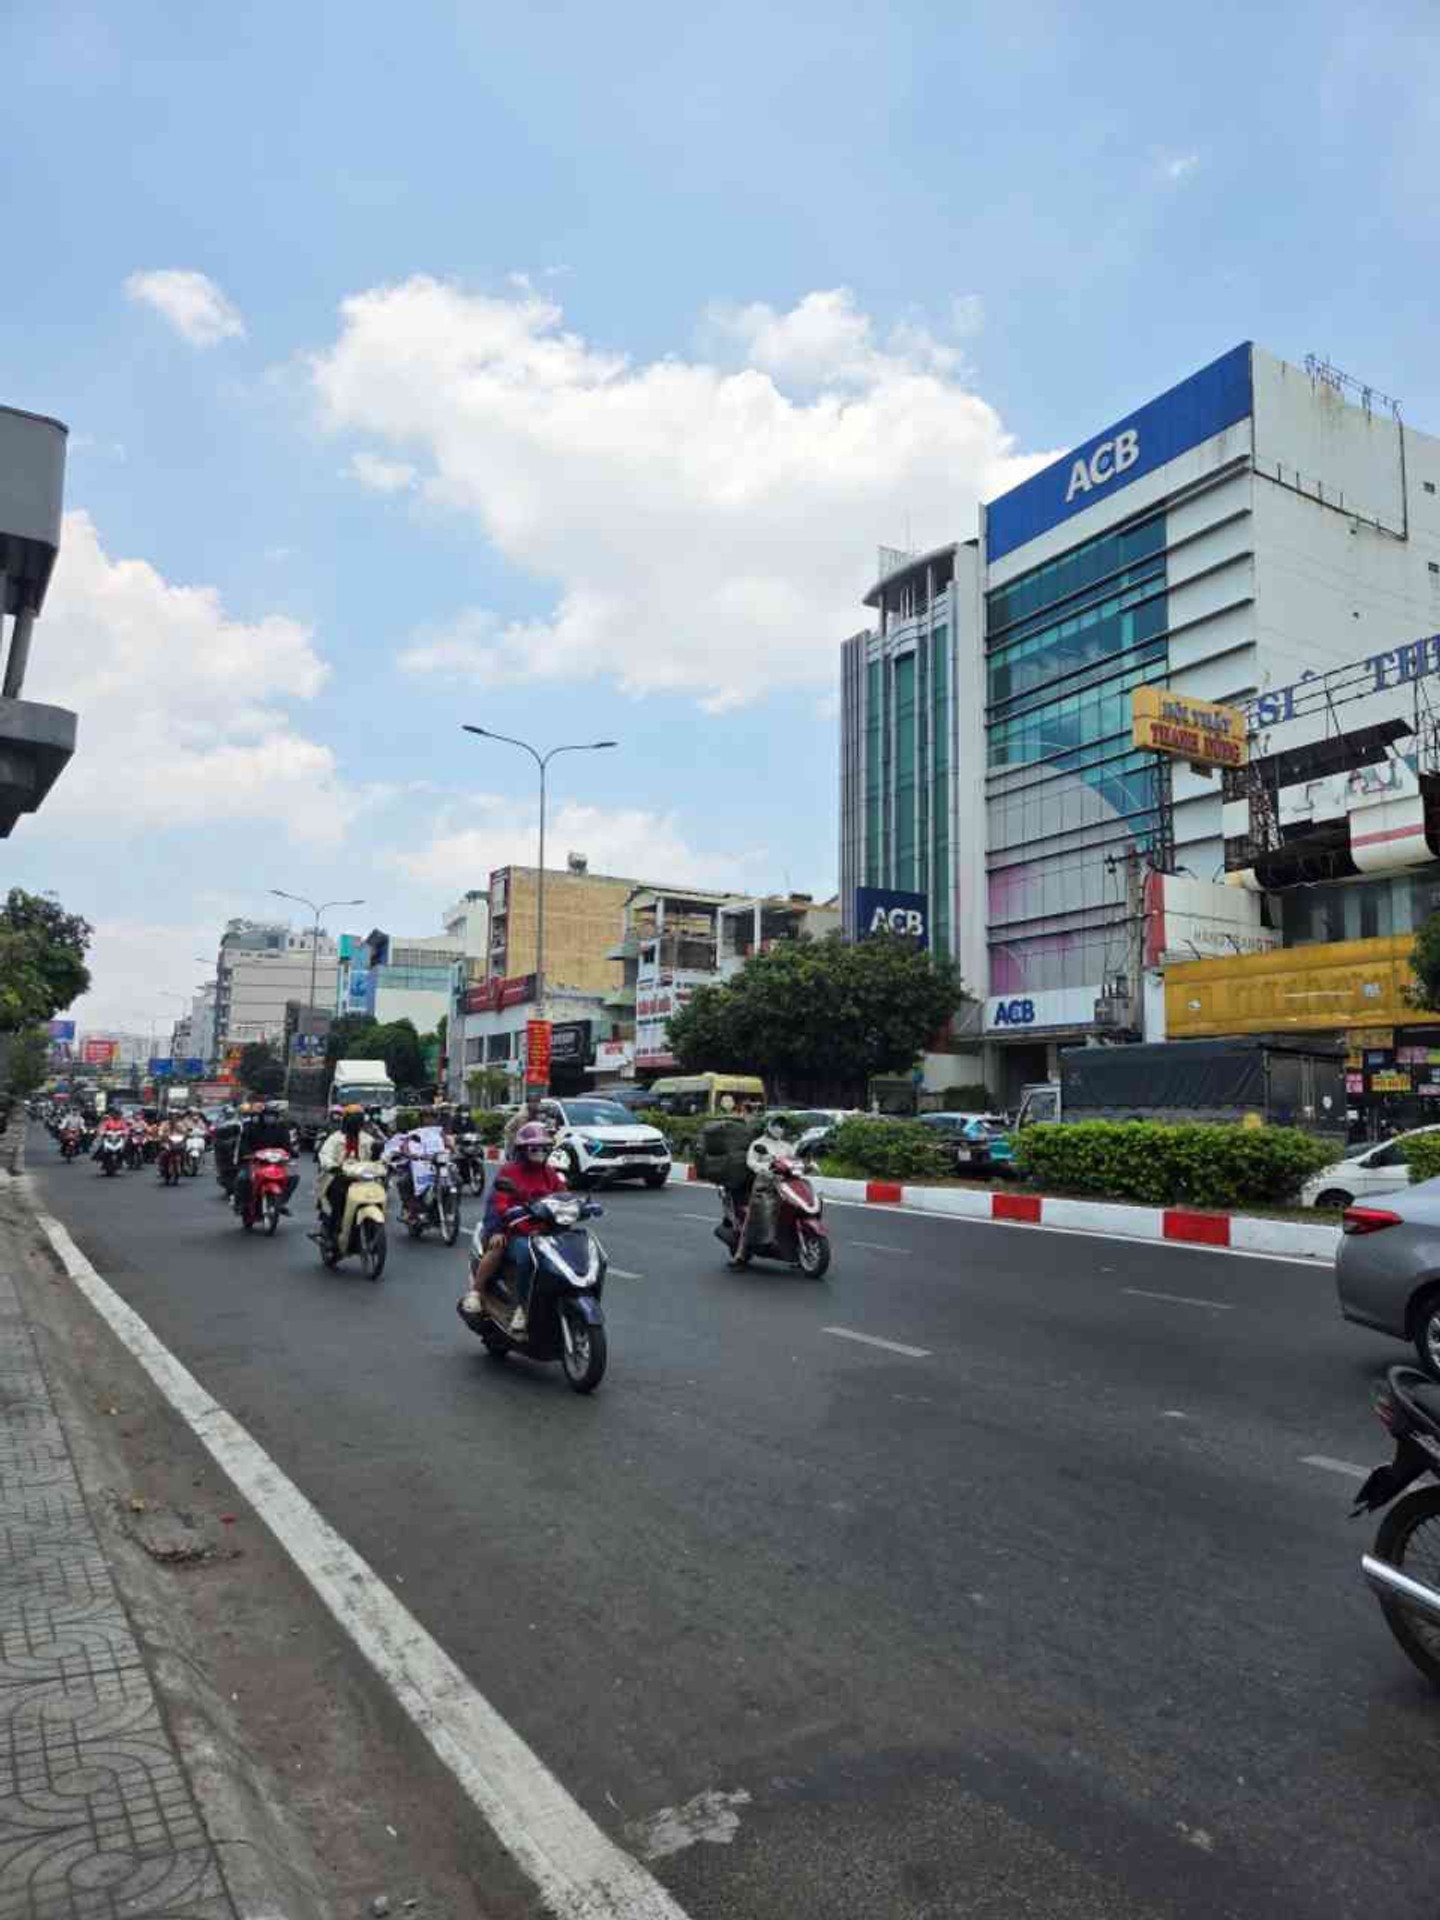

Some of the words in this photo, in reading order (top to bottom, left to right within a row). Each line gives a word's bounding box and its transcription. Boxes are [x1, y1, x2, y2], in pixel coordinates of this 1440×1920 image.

[1066, 428, 1139, 503] ACB
[870, 906, 924, 937] ACB
[994, 999, 1034, 1026] ACB
